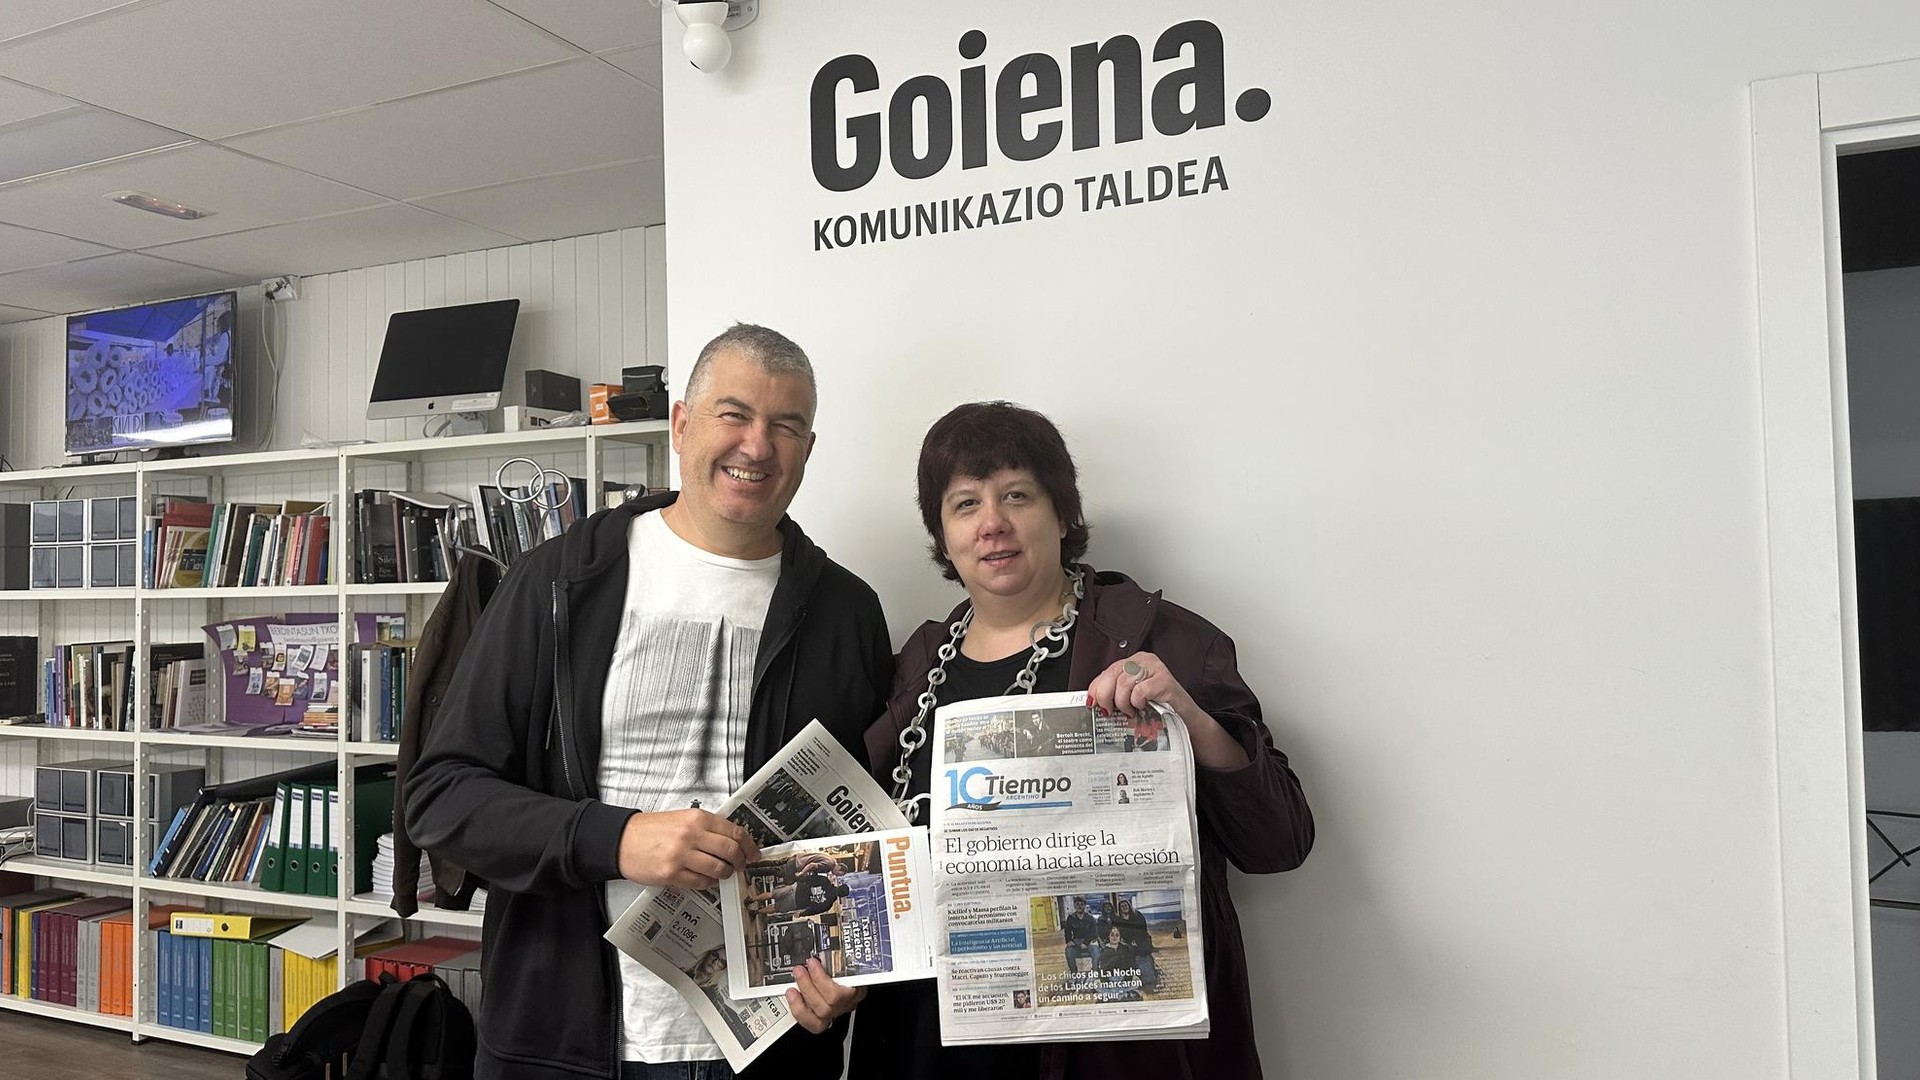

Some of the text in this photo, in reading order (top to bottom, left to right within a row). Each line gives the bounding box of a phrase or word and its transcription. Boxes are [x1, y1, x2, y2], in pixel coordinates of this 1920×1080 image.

[809, 19, 1272, 193] Goiena.
[814, 155, 1230, 251] KOMUNIKAZIO TALDEA
[985, 775, 1072, 798] Tiempo
[1006, 793, 1040, 801] ARGENTINO
[967, 803, 983, 811] AÑOS
[946, 830, 1116, 856] El gobierno dirige la
[946, 849, 1179, 874] economía hacia la recesión
[886, 836, 913, 920] Puntua.
[977, 912, 1006, 920] peronismo
[990, 905, 1011, 913] perfilan
[842, 924, 854, 958] lanak
[852, 921, 864, 960] atzeko
[861, 916, 873, 962] Txaloen
[1059, 970, 1087, 980] chicos
[1087, 969, 1099, 979] de
[1100, 968, 1112, 978] La
[1113, 967, 1142, 977] Noche
[1037, 984, 1049, 992] de
[1050, 983, 1063, 992] los
[1065, 981, 1098, 992] Lápices
[1100, 979, 1143, 989] marcaron
[963, 999, 986, 1008] pidieron
[1038, 995, 1050, 1003] un
[1051, 993, 1084, 1002] camino
